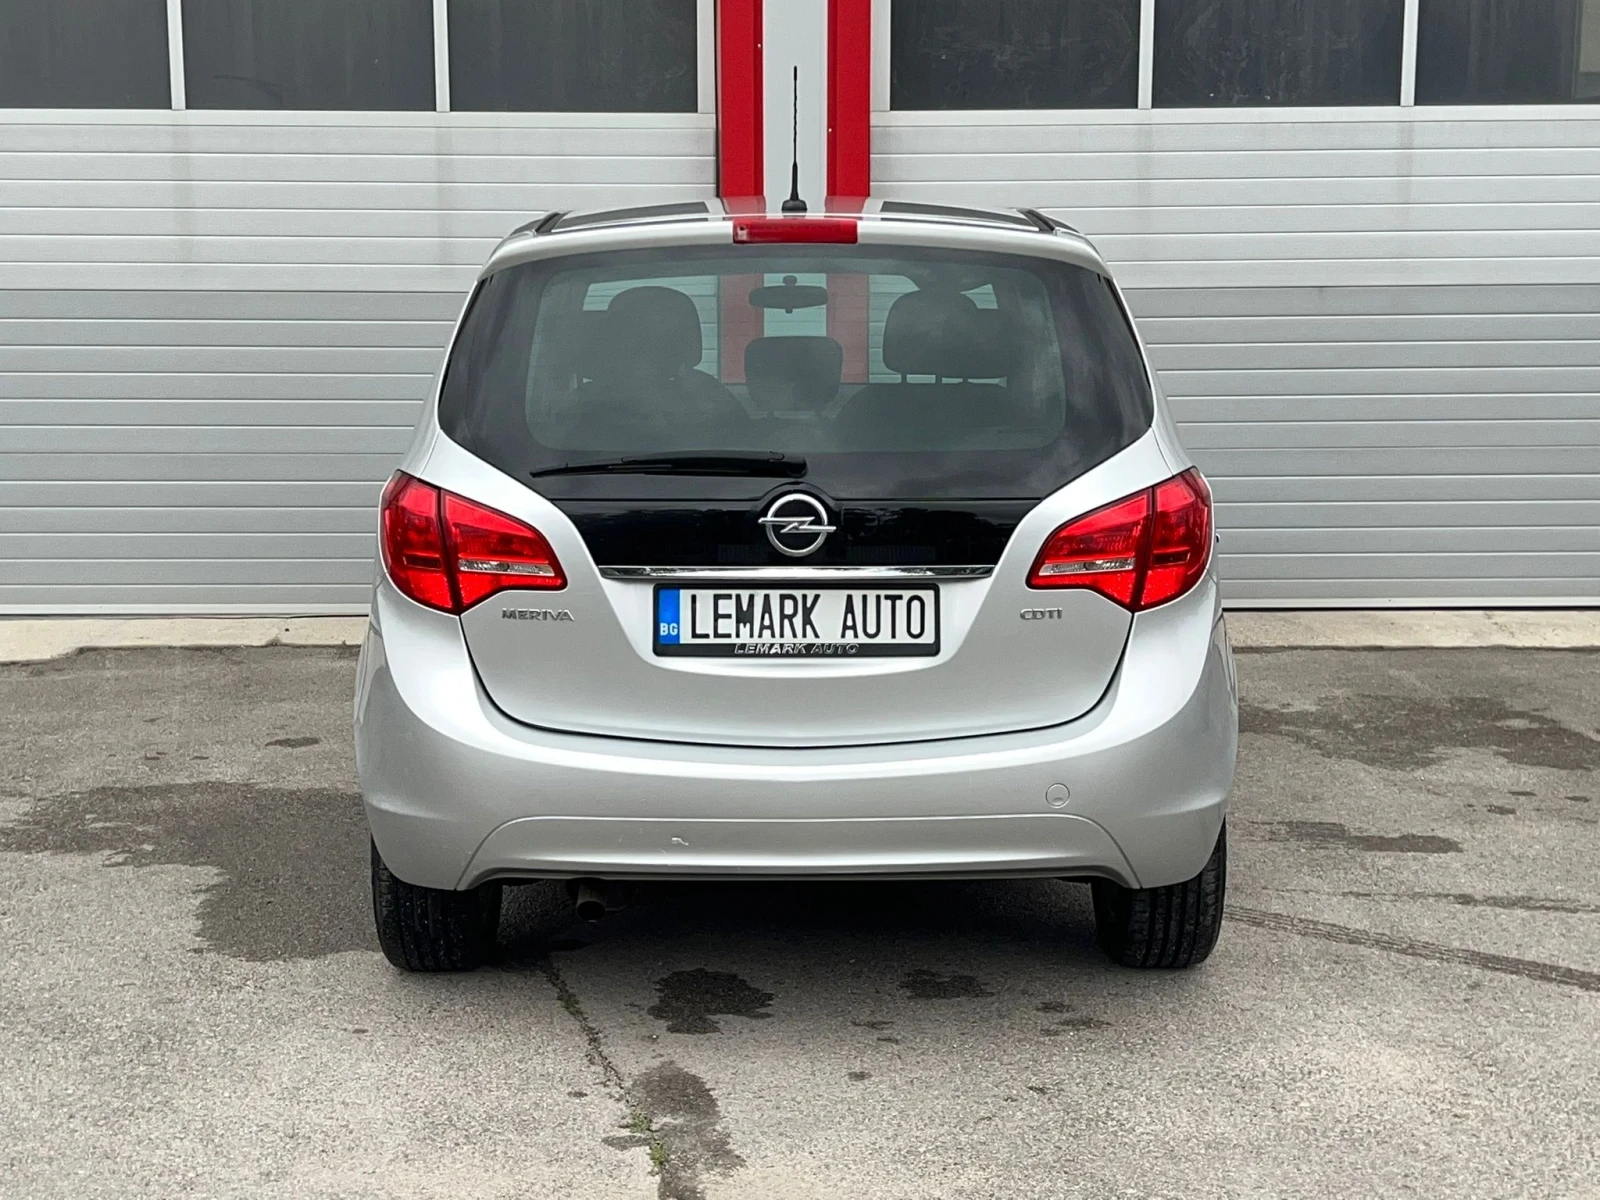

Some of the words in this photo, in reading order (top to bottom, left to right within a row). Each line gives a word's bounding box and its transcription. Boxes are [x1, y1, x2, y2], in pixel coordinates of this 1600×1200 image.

[501, 607, 575, 621] MERIVA
[691, 593, 821, 639] LEMARK
[840, 593, 926, 639] AUTO
[1020, 607, 1063, 620] CDTI
[660, 622, 678, 636] BG
[733, 643, 807, 655] LEMARK
[810, 643, 860, 655] AUTO
